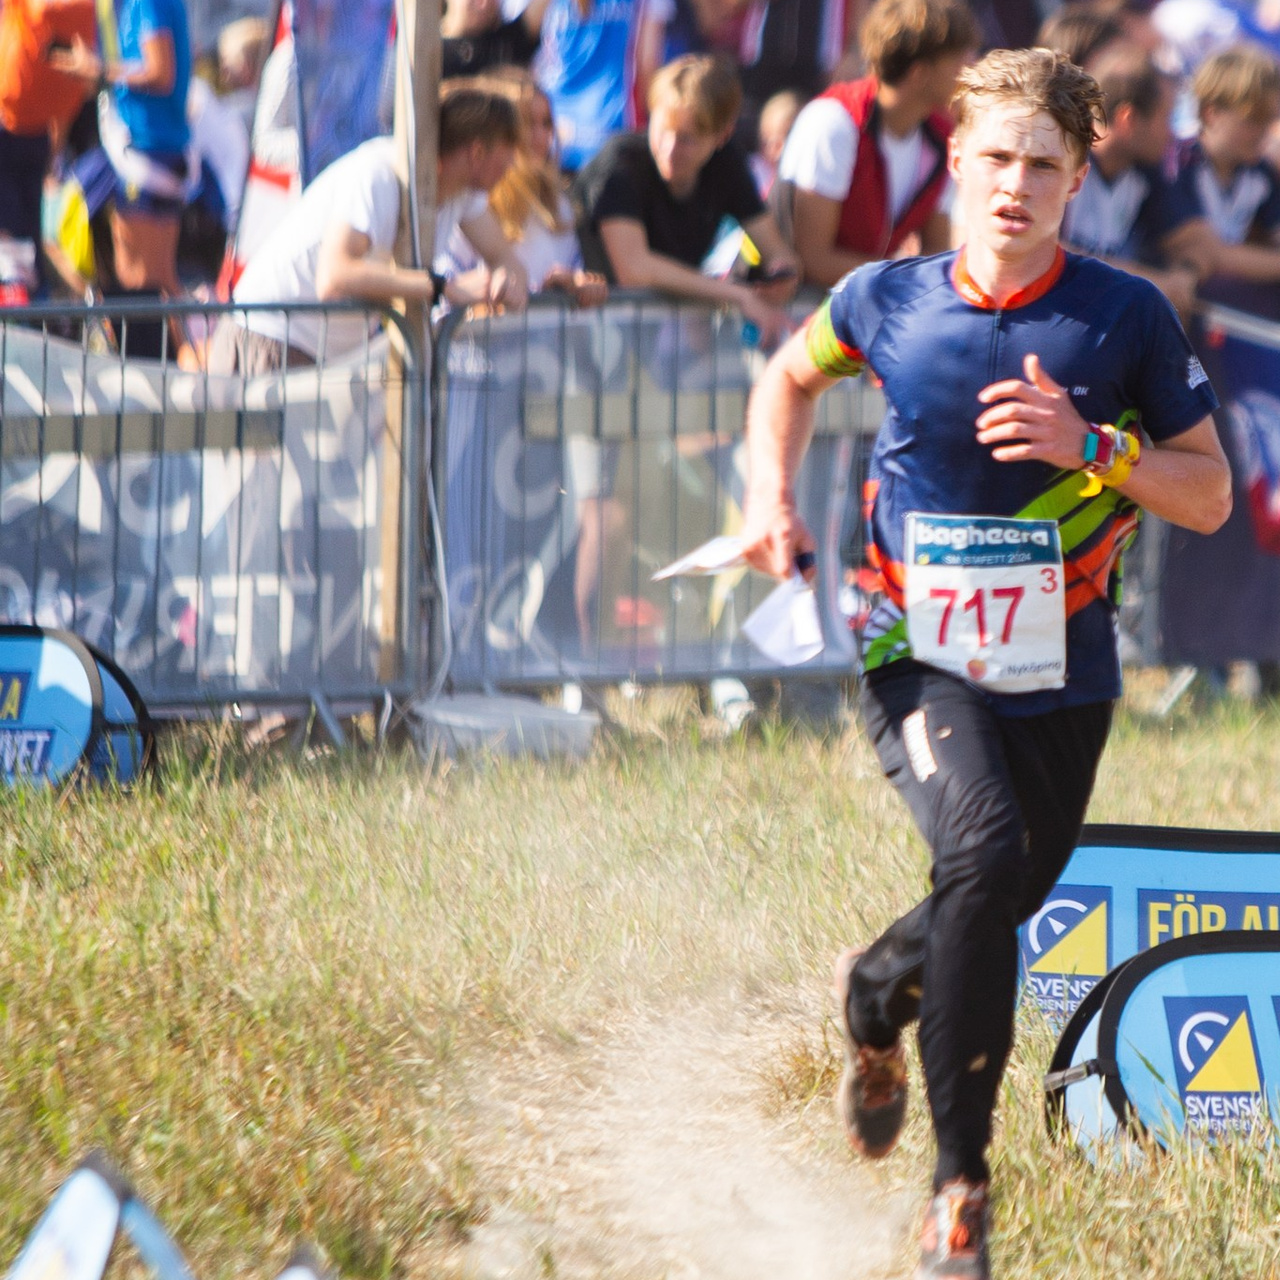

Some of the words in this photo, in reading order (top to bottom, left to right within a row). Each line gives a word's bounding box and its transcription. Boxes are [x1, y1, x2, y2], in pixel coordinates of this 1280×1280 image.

[915, 523, 1049, 550] bagheera
[1040, 567, 1058, 594] 3
[929, 586, 1025, 647] 717
[1185, 1095, 1264, 1117] SVENSK
